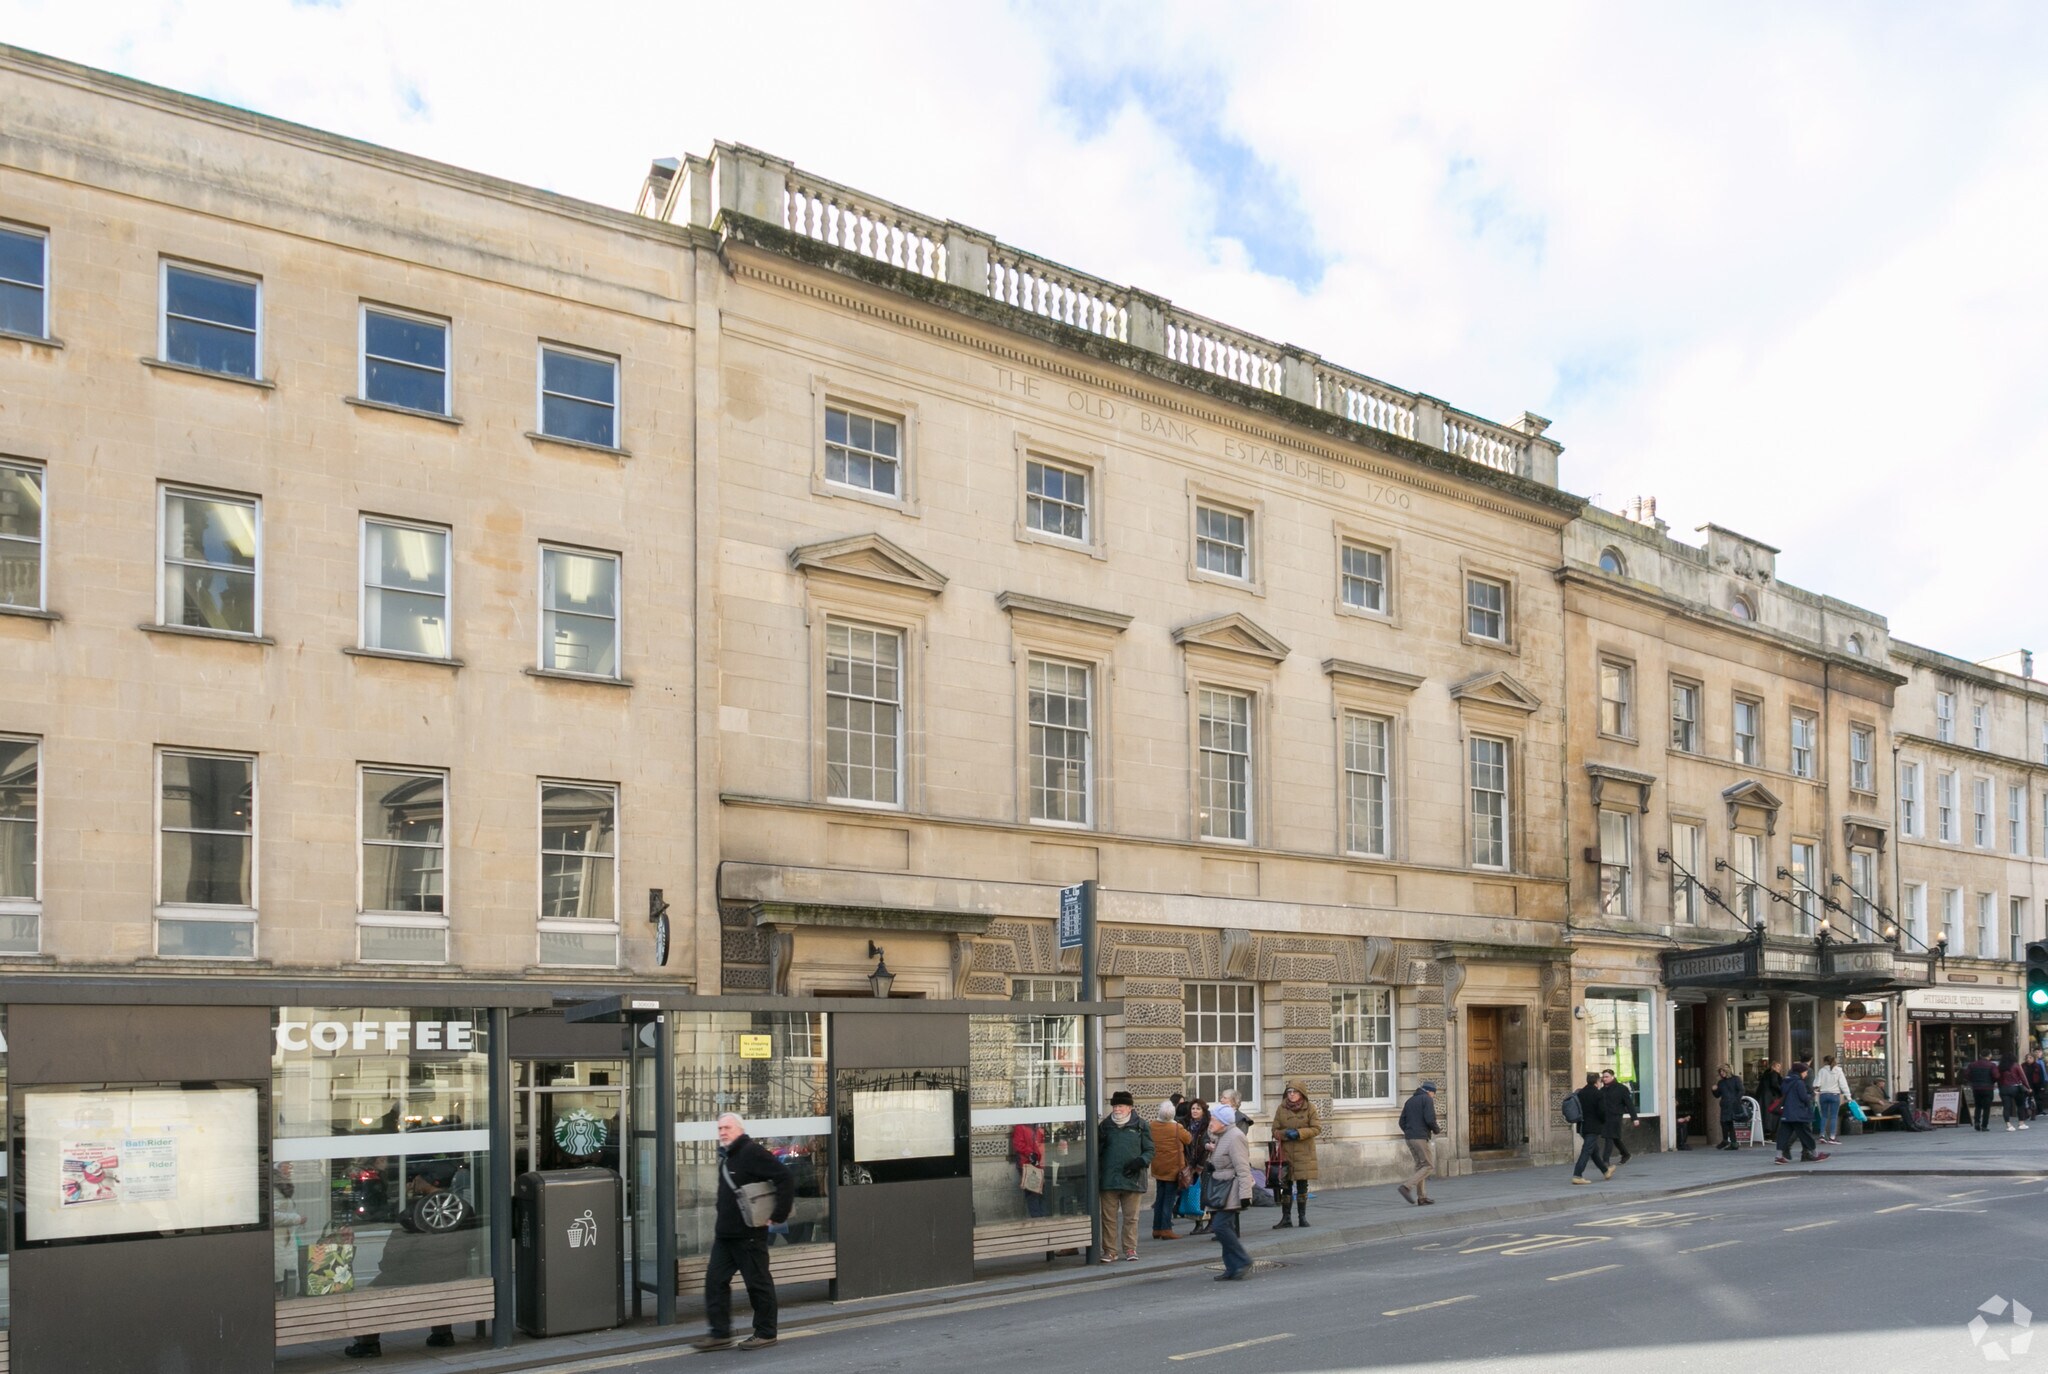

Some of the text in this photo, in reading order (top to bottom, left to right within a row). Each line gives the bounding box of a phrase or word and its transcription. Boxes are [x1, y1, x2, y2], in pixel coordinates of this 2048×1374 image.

[992, 365, 1410, 510] THE OLD BANK ESTABLISHED 1760
[1672, 955, 1744, 977] CORRIDOR
[276, 1021, 472, 1051] COFFEE
